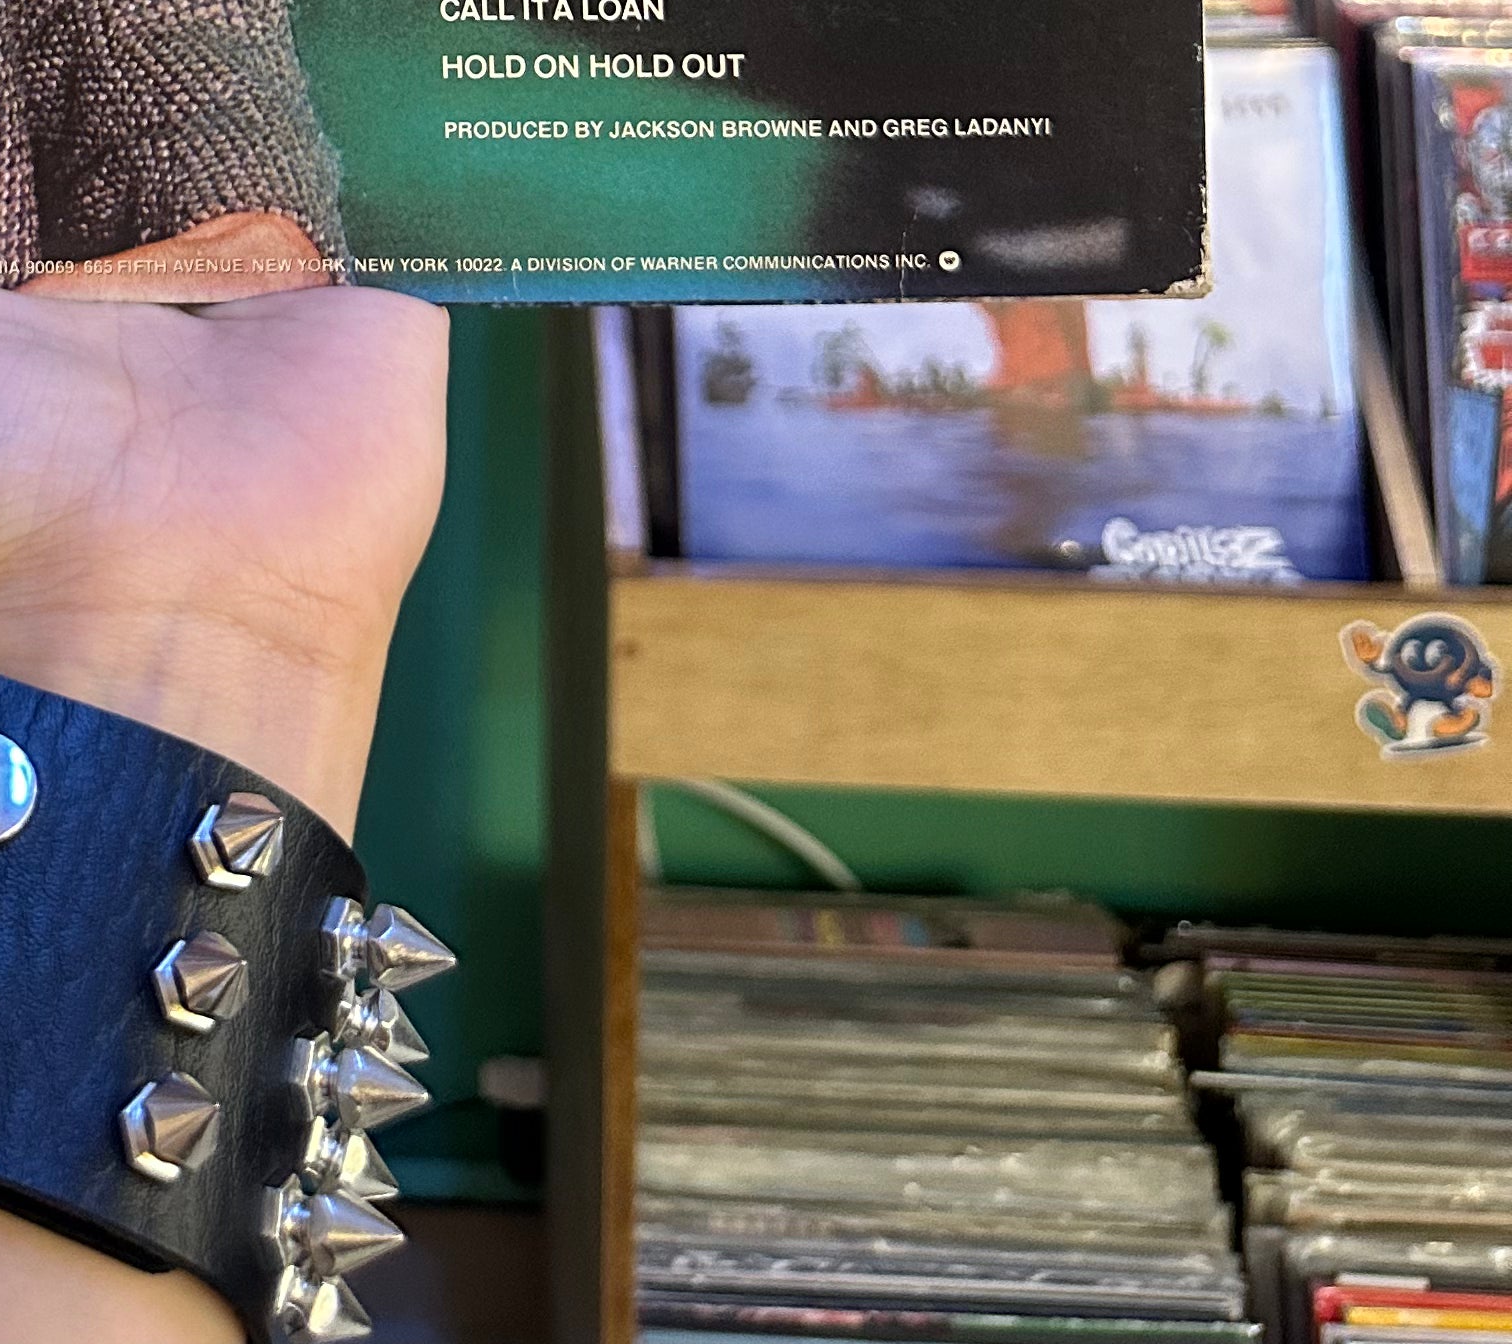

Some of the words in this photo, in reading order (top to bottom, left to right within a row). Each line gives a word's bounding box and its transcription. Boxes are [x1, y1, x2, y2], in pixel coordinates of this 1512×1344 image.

[442, 54, 526, 79] HOLD
[534, 54, 580, 79] ON
[589, 54, 674, 79] HOLD
[681, 53, 745, 78] OUT
[444, 121, 569, 139] PRODUCED
[575, 121, 604, 139] BY
[609, 120, 714, 139] JACKSON
[721, 119, 822, 137] BROWNE
[828, 118, 877, 137] AND
[882, 118, 948, 137] GREG
[954, 117, 1051, 136] LADANYI
[83, 260, 113, 274] 665
[117, 259, 168, 274] FIFTH
[251, 258, 292, 272] NEW
[354, 257, 395, 272] NEW
[399, 257, 448, 272] YORK
[510, 257, 523, 271] A
[527, 256, 606, 272] DIVISION
[611, 256, 636, 271] OF
[640, 255, 718, 271] WARNER
[722, 254, 889, 270] COMMUNICATIONS
[895, 253, 931, 269] INC.
